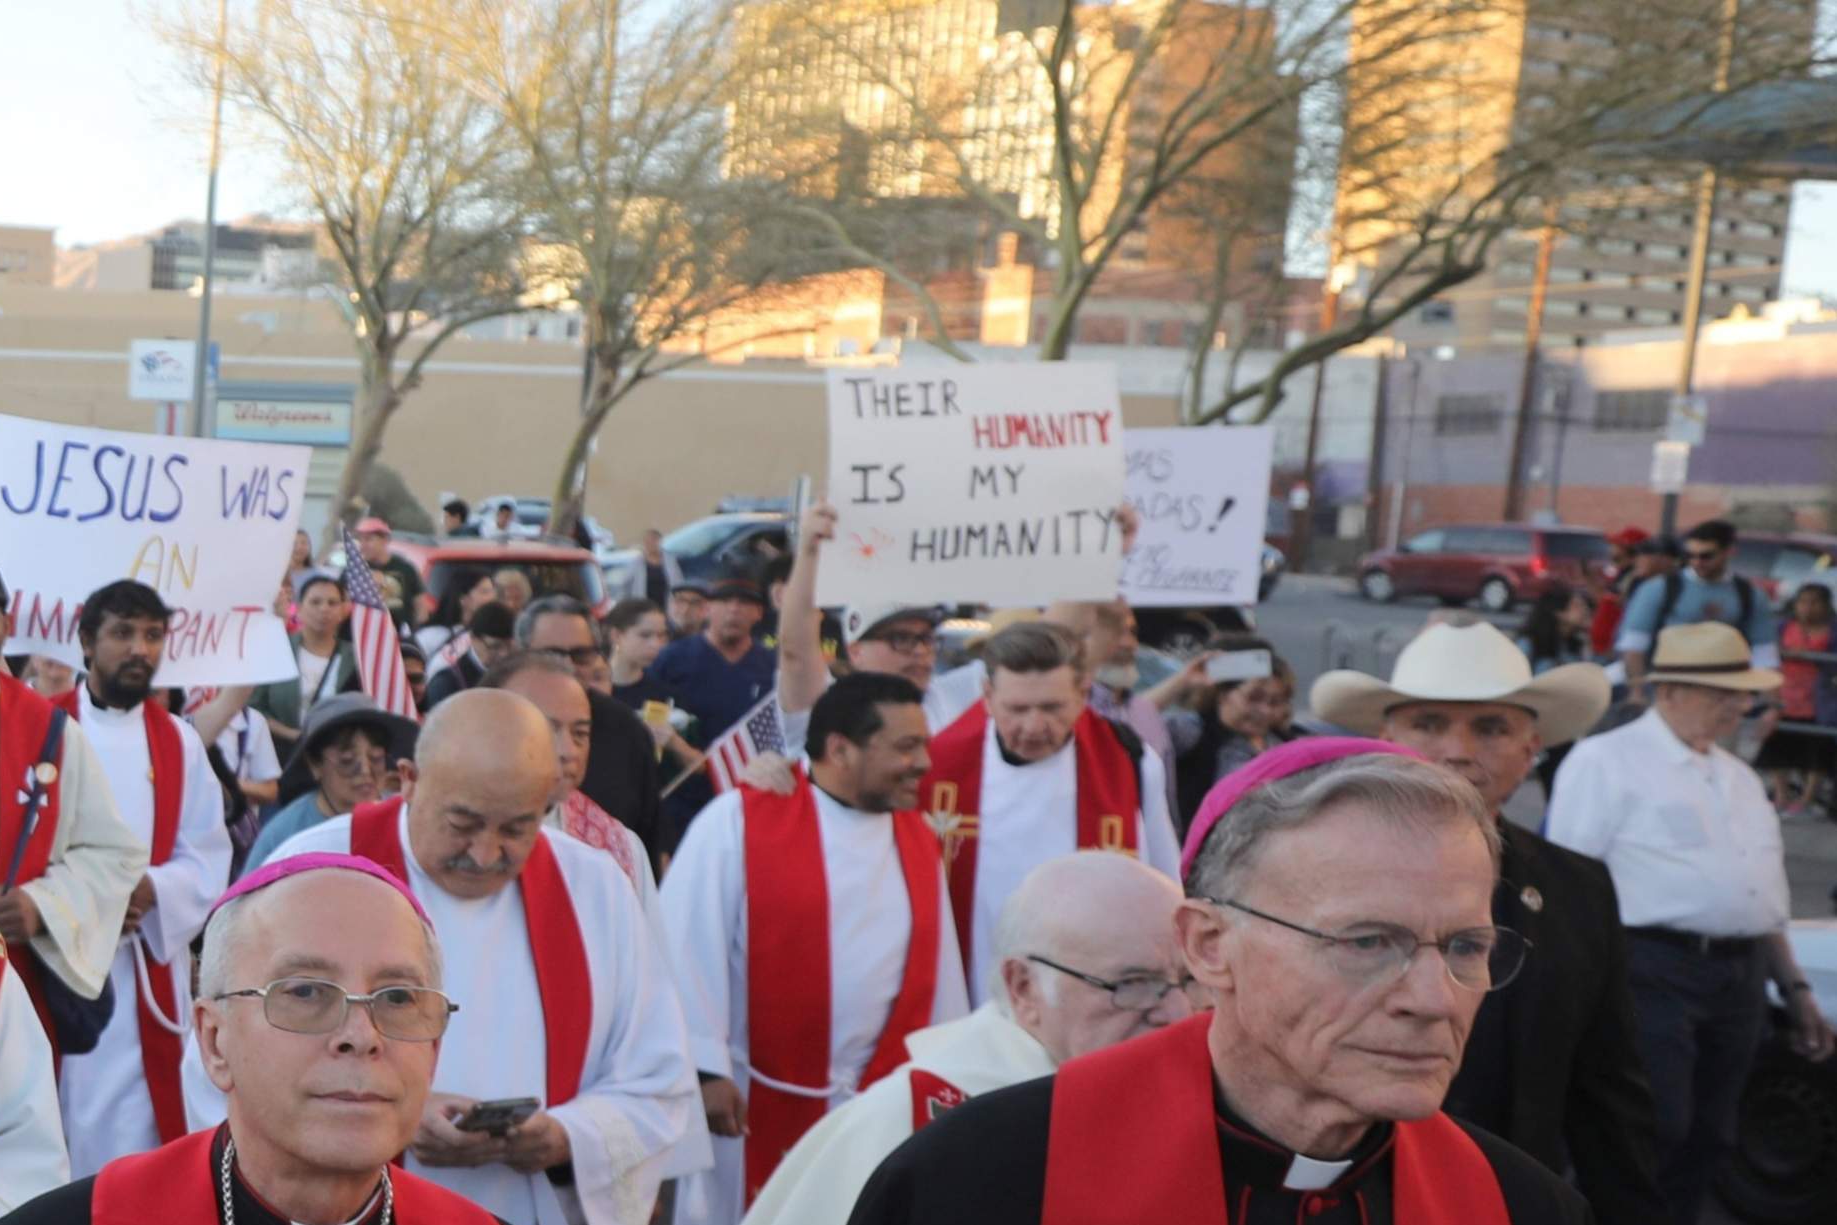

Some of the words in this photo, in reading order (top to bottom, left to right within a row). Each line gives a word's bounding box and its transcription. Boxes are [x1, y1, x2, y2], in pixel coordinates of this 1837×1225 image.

[845, 377, 962, 418] THEIR
[971, 410, 1112, 449] HUMANITY
[1, 440, 189, 523] JESUS
[220, 464, 294, 521] WAS
[850, 464, 906, 504] IS
[969, 463, 1025, 500] MY
[910, 508, 1116, 562] HUMANITY
[129, 534, 199, 592] AN
